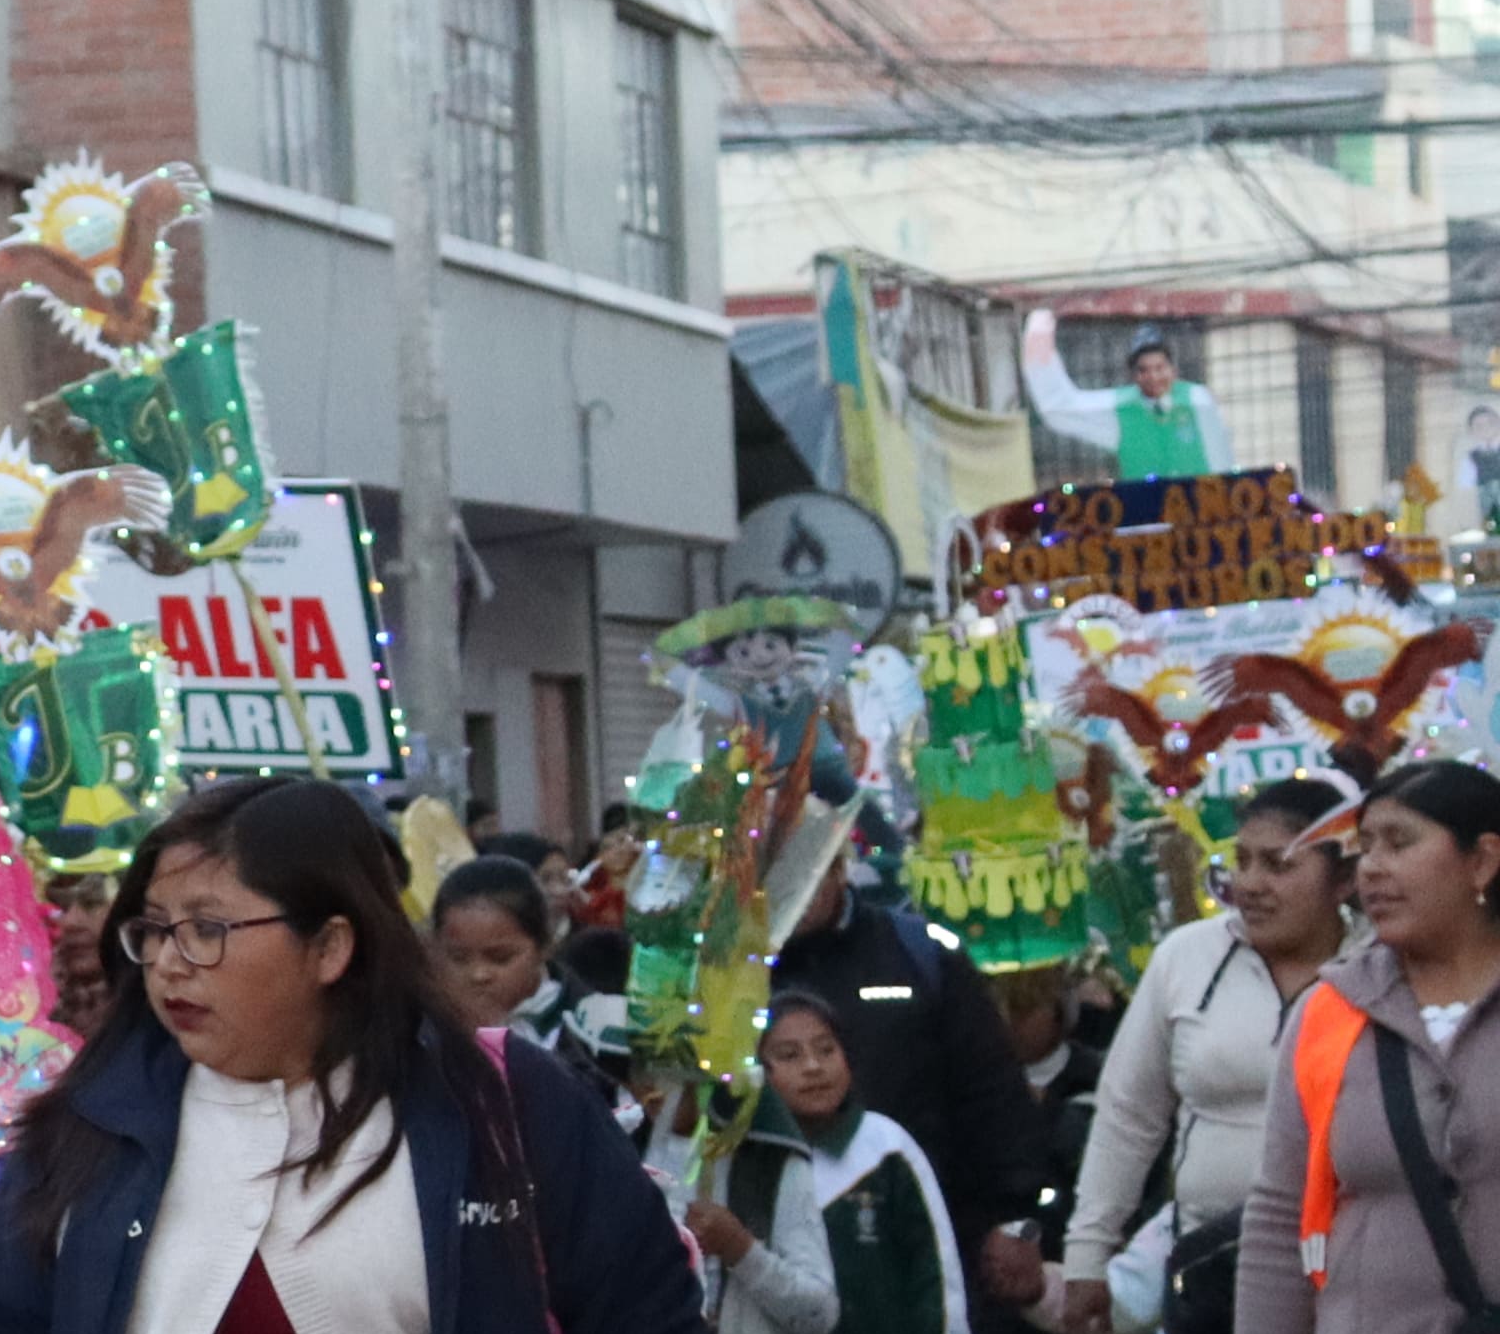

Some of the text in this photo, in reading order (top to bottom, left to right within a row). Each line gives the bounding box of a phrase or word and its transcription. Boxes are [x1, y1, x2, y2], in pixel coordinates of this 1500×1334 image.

[1047, 489, 1124, 531] 20
[982, 511, 1389, 587] CONSTRUYENDO
[158, 595, 347, 680] ALFA
